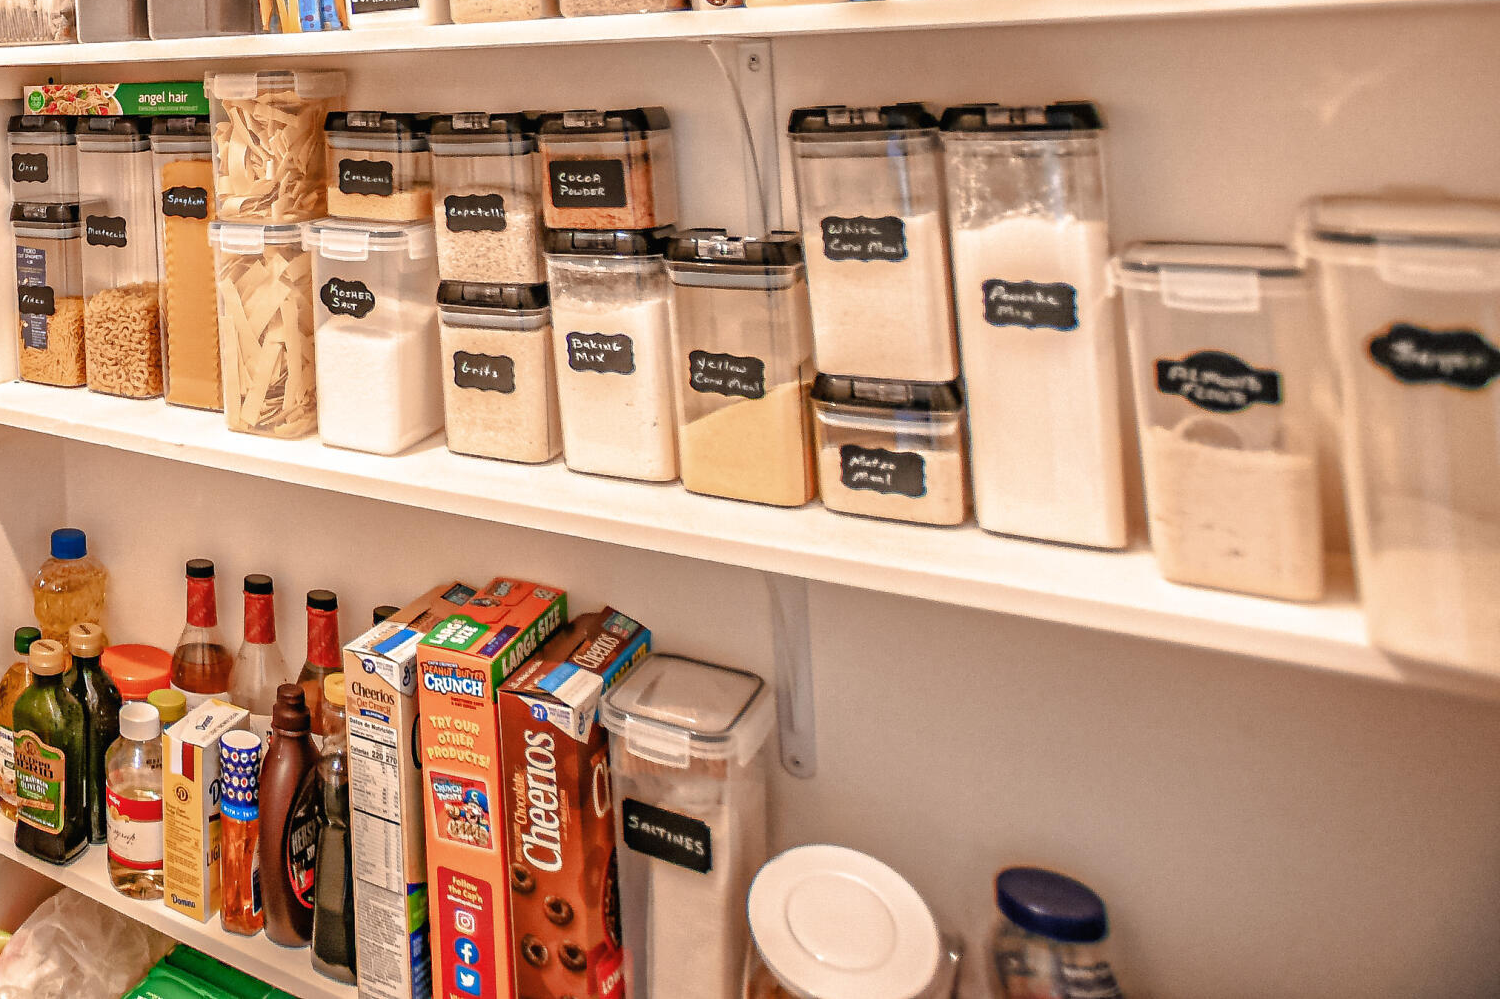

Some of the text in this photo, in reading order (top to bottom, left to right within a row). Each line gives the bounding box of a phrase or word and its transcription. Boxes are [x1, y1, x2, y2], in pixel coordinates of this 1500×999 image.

[138, 90, 188, 105] angel hair
[557, 172, 601, 183] COCOA
[560, 184, 606, 196] POWDER
[429, 618, 467, 645] LARGE
[450, 624, 479, 645] SIZE
[501, 628, 538, 678] LARGE
[537, 603, 561, 642] SIZE
[573, 632, 620, 669] Cheerios
[422, 663, 486, 682] PEANUT BUTTER
[351, 680, 395, 706] Cheerios
[423, 672, 484, 697] CRUNCH
[349, 716, 364, 726] Datos
[533, 705, 545, 720] 21
[428, 715, 481, 736] TRY OUR
[437, 730, 475, 749] OTHER
[371, 750, 398, 764] 220 270
[426, 747, 492, 769] PRODUCTS!
[514, 767, 528, 825] Chocolate
[521, 729, 563, 873] Cheerios
[291, 818, 317, 857] HERS
[451, 875, 478, 892] Follow
[170, 893, 196, 909] Domino
